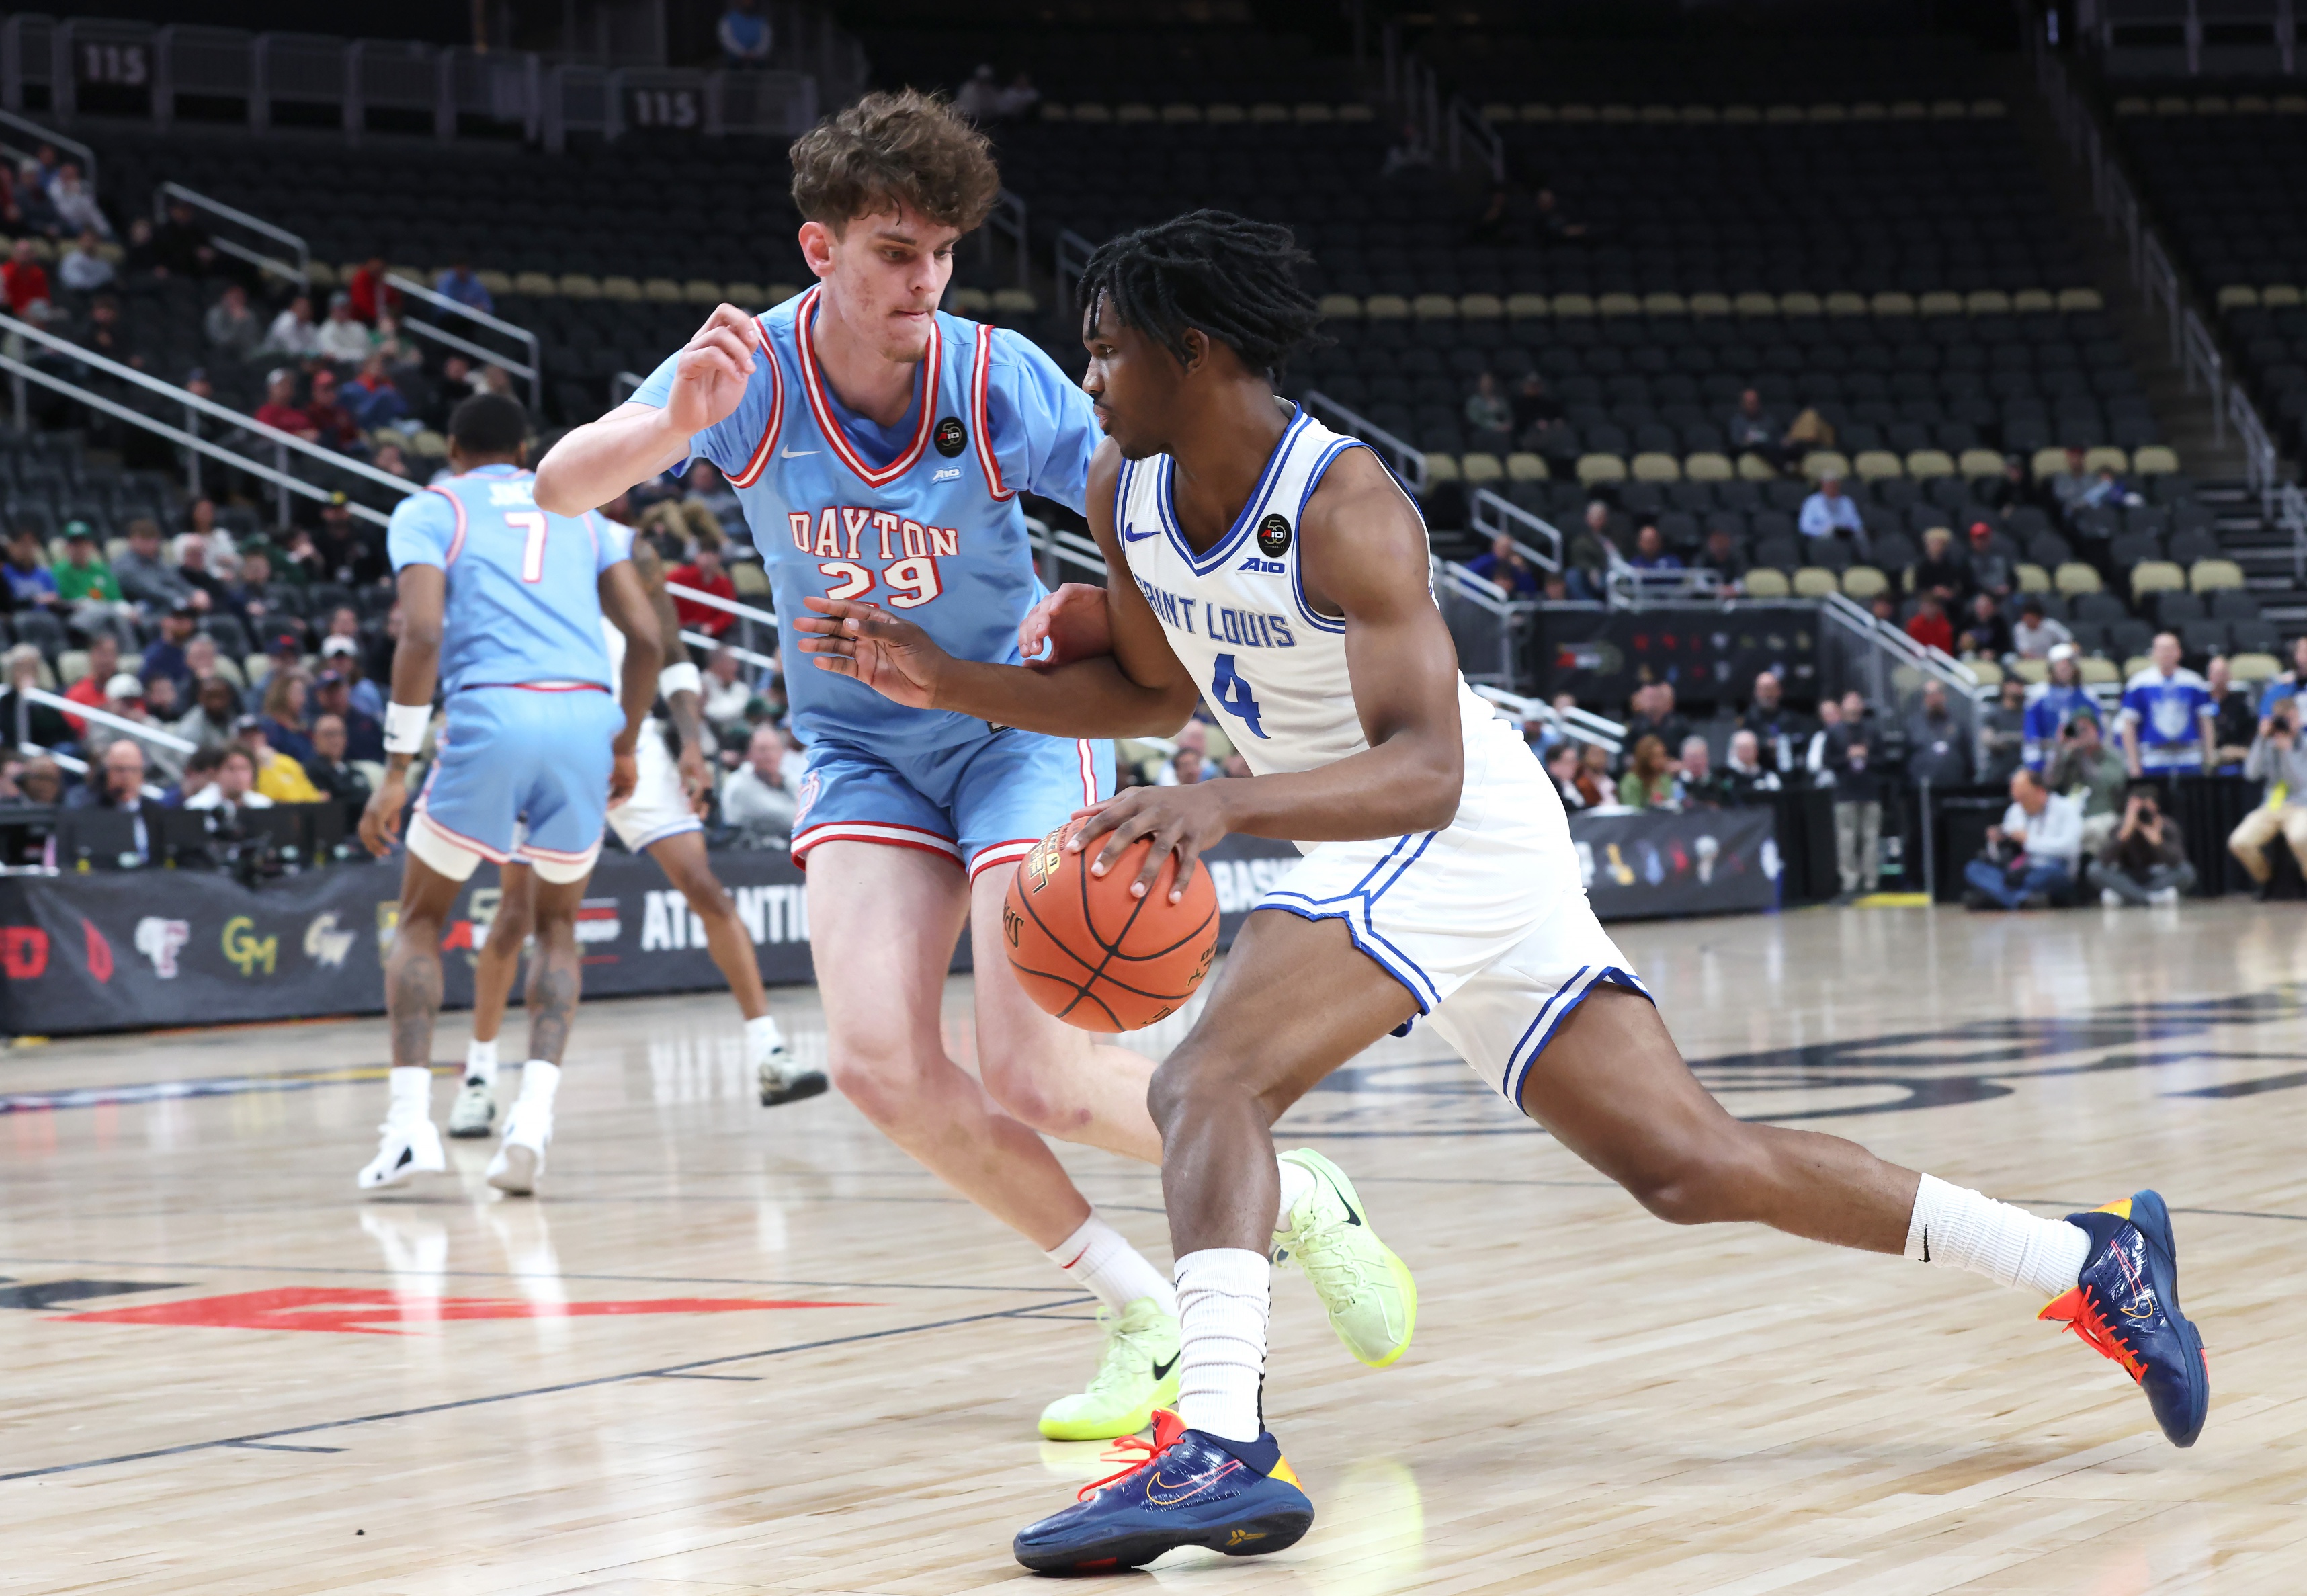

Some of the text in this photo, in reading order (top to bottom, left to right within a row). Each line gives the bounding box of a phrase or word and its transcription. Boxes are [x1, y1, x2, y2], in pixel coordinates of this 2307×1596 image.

[85, 44, 146, 85] 115
[636, 90, 696, 128] 115
[932, 468, 960, 481] A10
[503, 511, 548, 584] 7
[788, 505, 960, 560] DAYTON
[1261, 529, 1284, 538] A10
[818, 556, 943, 610] 29
[1237, 557, 1285, 574] A10
[1205, 601, 1298, 648] LOUIS
[1212, 653, 1271, 739] 4
[641, 884, 810, 952] ATLNTI
